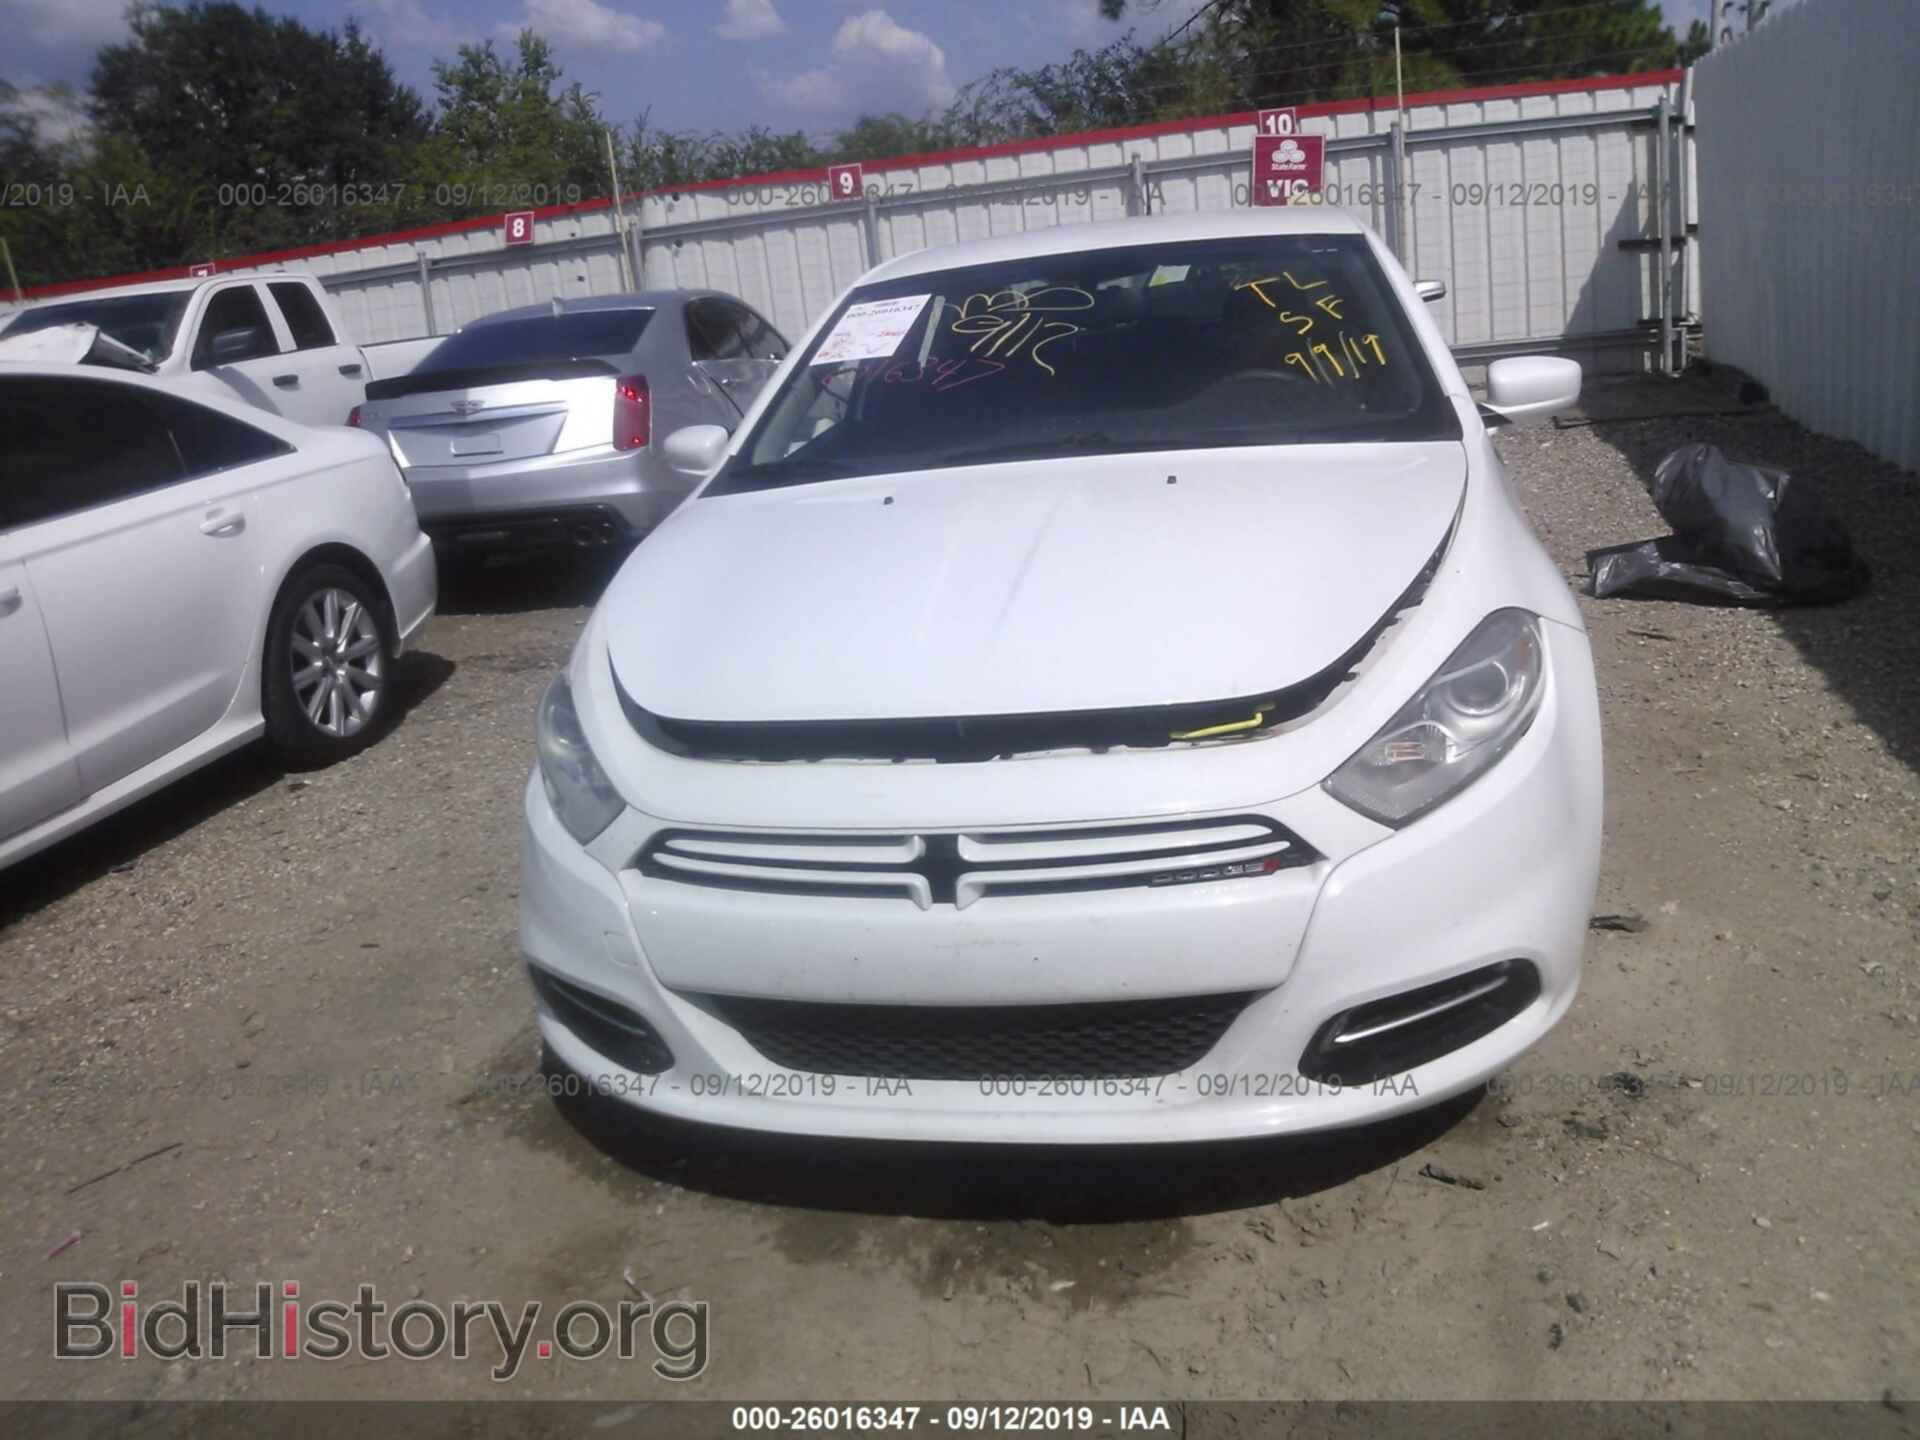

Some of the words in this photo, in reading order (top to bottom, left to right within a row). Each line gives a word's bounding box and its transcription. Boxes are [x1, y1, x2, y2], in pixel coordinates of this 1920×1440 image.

[1265, 113, 1293, 136] 10
[839, 171, 854, 195] 9
[511, 217, 525, 238] 8
